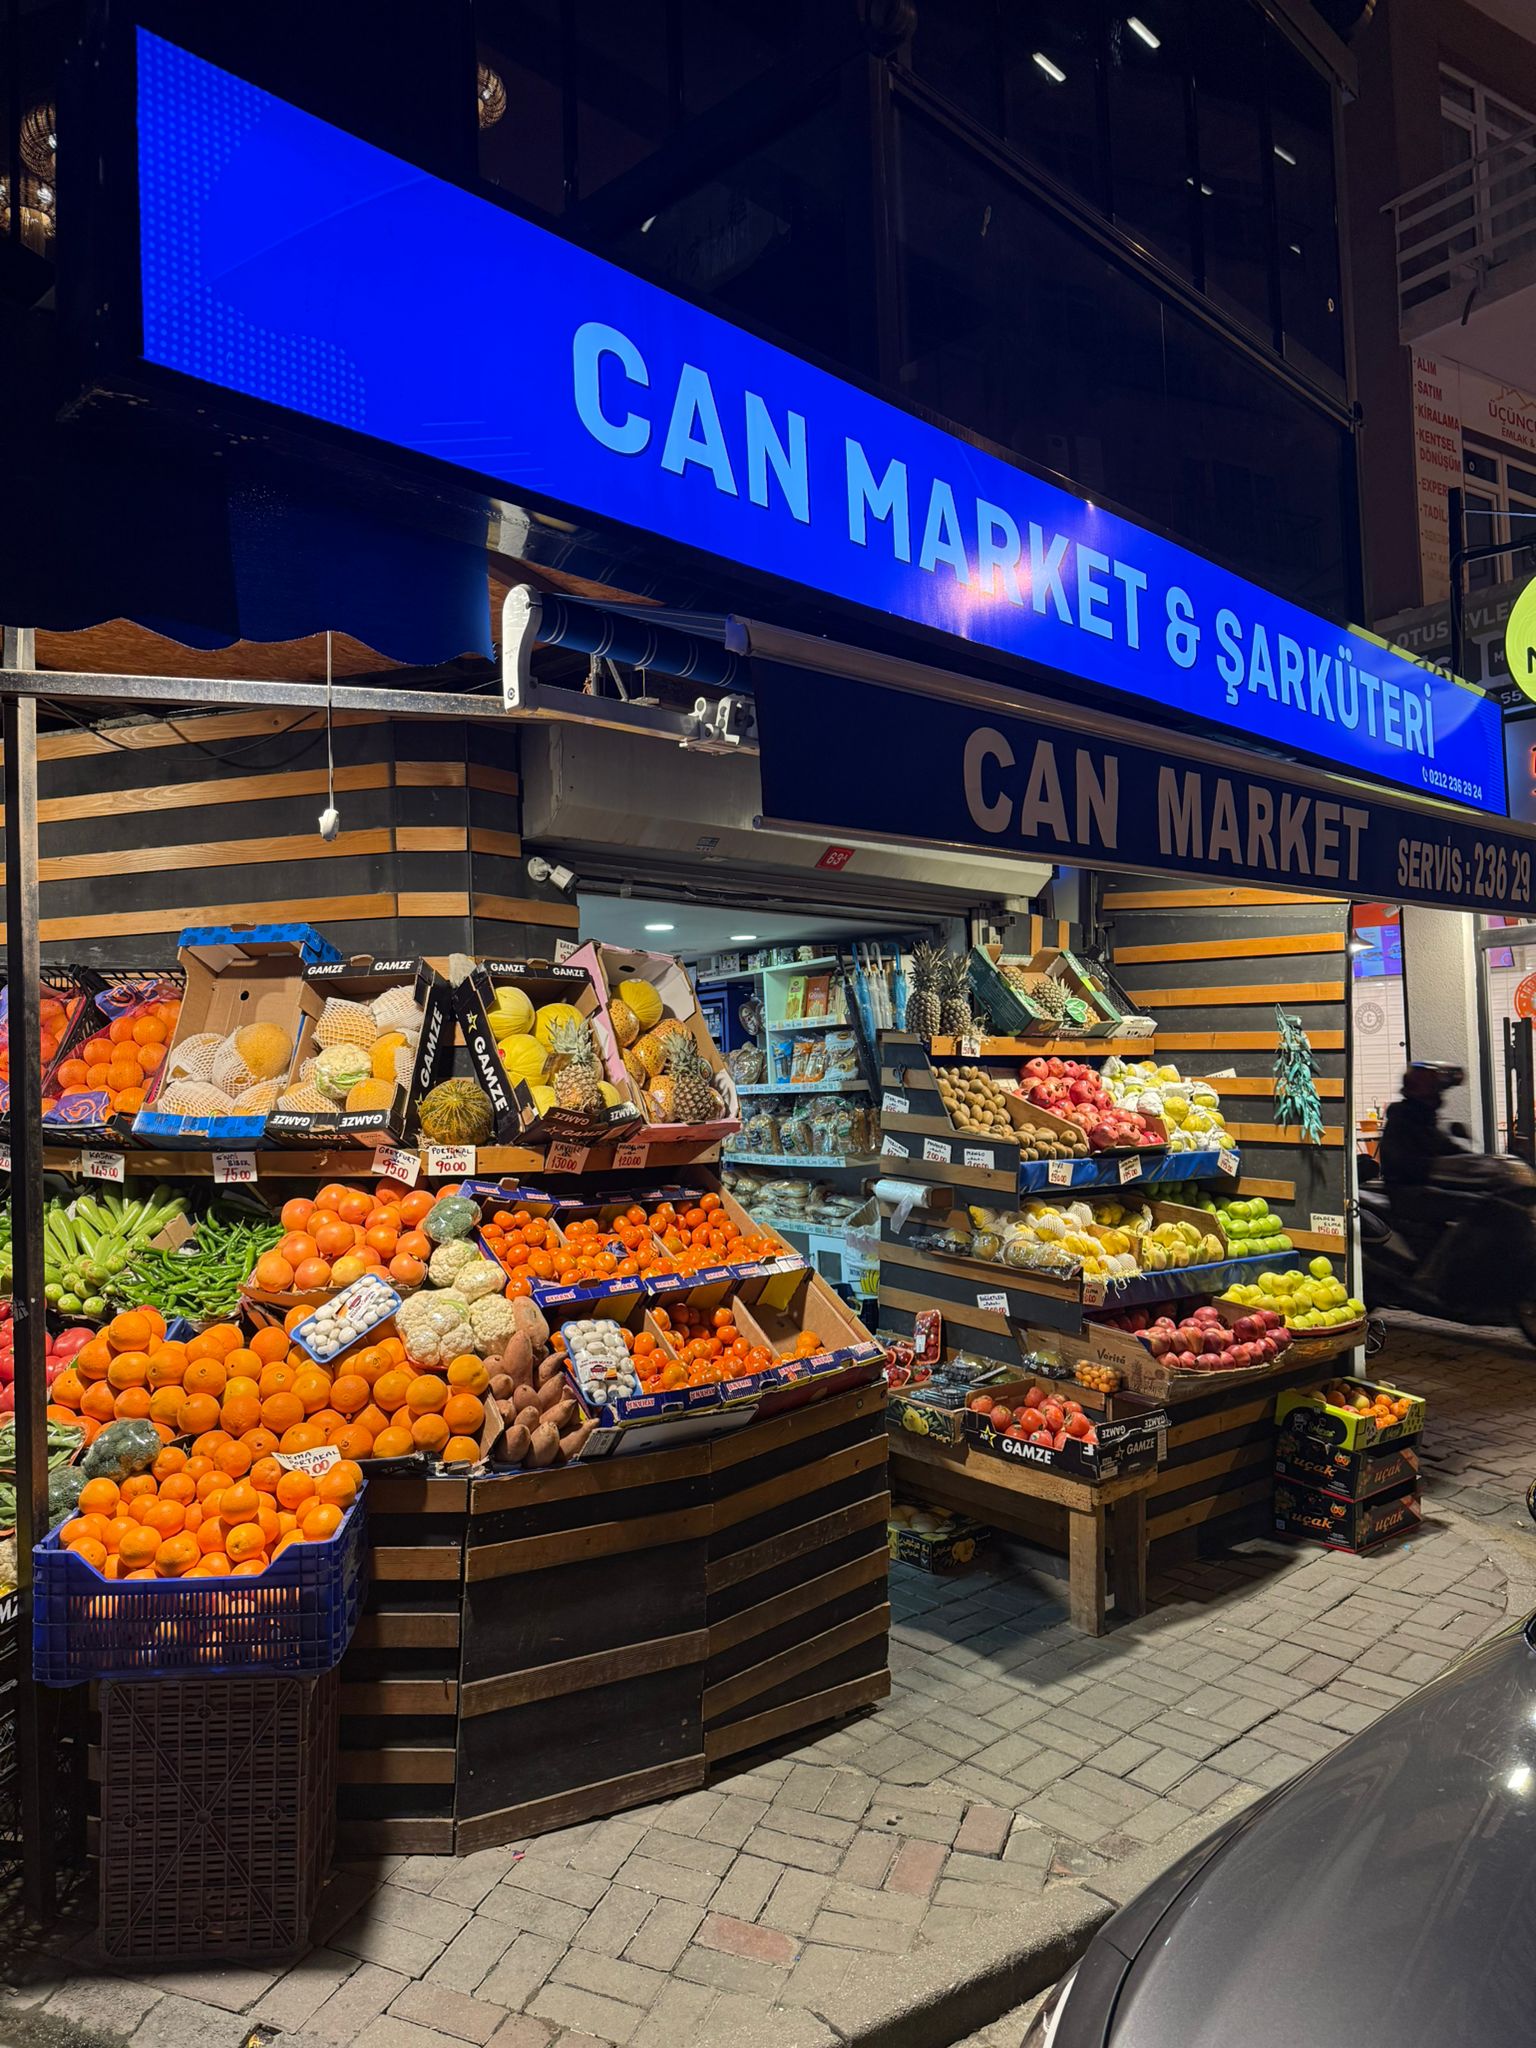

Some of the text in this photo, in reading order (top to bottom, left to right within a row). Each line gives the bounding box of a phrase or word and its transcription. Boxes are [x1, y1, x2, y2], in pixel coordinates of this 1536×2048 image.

[1417, 357, 1437, 376] ALIM
[1417, 381, 1443, 401] SATIM
[1418, 403, 1460, 432] KİRALAMA
[1488, 400, 1536, 433] ÜÇÜNC
[1419, 428, 1457, 453] KENTSEL
[1501, 427, 1528, 446] EMLAK
[1420, 447, 1462, 472] DÖNÜŞÜM
[1423, 504, 1448, 523] TADİL
[573, 322, 1435, 758] CAN MARKET & ŞARKÜTERİ
[1429, 768, 1482, 801] 0212 236 29 24
[963, 727, 1370, 882] CAN MARKET
[1474, 842, 1508, 900] 236
[1511, 849, 1531, 903] 29
[307, 964, 346, 975] GAMZE
[374, 960, 414, 971] GAMZE
[490, 963, 526, 973] GAMZE
[552, 967, 586, 977] GAMZE
[421, 1007, 442, 1088] GAMZE
[474, 1036, 508, 1112] GAMZE
[271, 1114, 311, 1127] GAMZE
[339, 1114, 383, 1127] GAMZE
[553, 1111, 590, 1126] GAMZE
[610, 1104, 637, 1121] GAMZE
[222, 1167, 251, 1184] 75.00
[383, 1159, 408, 1180] 95.00
[436, 1160, 467, 1173] 90.00
[1102, 1425, 1126, 1439] GAMZE
[1001, 1438, 1055, 1465] GAMZE
[1126, 1437, 1155, 1455] GAMZE
[1294, 1457, 1337, 1478] uçak
[1373, 1459, 1403, 1484] uçak
[1291, 1512, 1334, 1530] uçak
[1375, 1509, 1405, 1533] uçak
